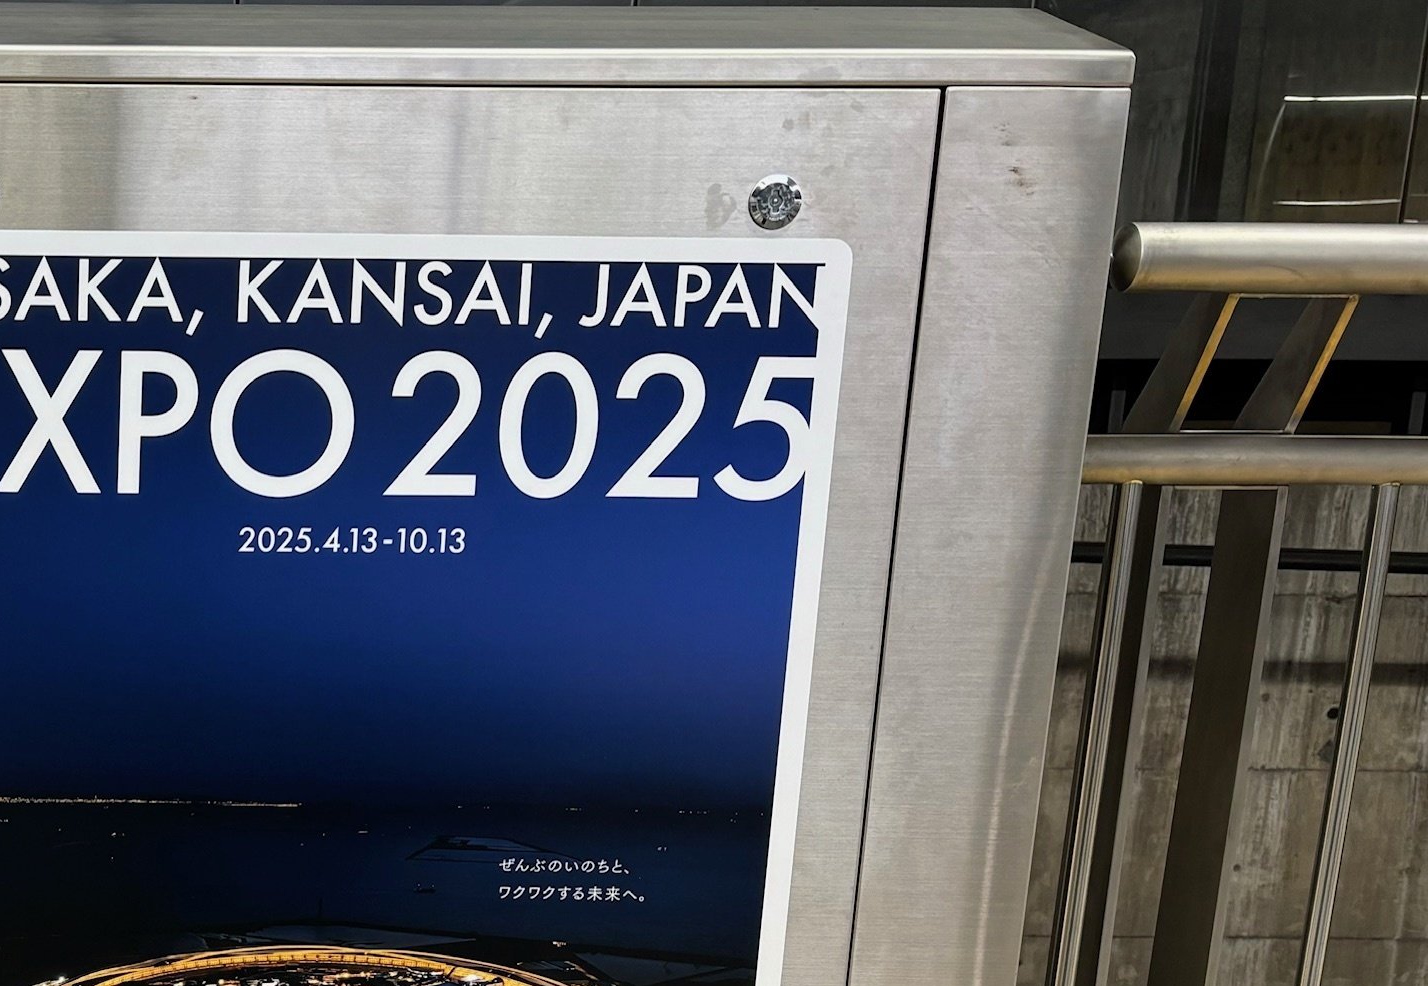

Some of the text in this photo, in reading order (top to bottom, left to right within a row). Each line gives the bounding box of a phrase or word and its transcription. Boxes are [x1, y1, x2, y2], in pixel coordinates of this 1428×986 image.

[237, 260, 552, 339] KANSAI,
[578, 264, 821, 330] JAPAN
[381, 350, 813, 501] 2025
[238, 526, 467, 556] 2025.4.13-10.13
[498, 858, 630, 875] ぜんぶのいのちと、
[498, 886, 645, 902] ワクワクする未来へ。
